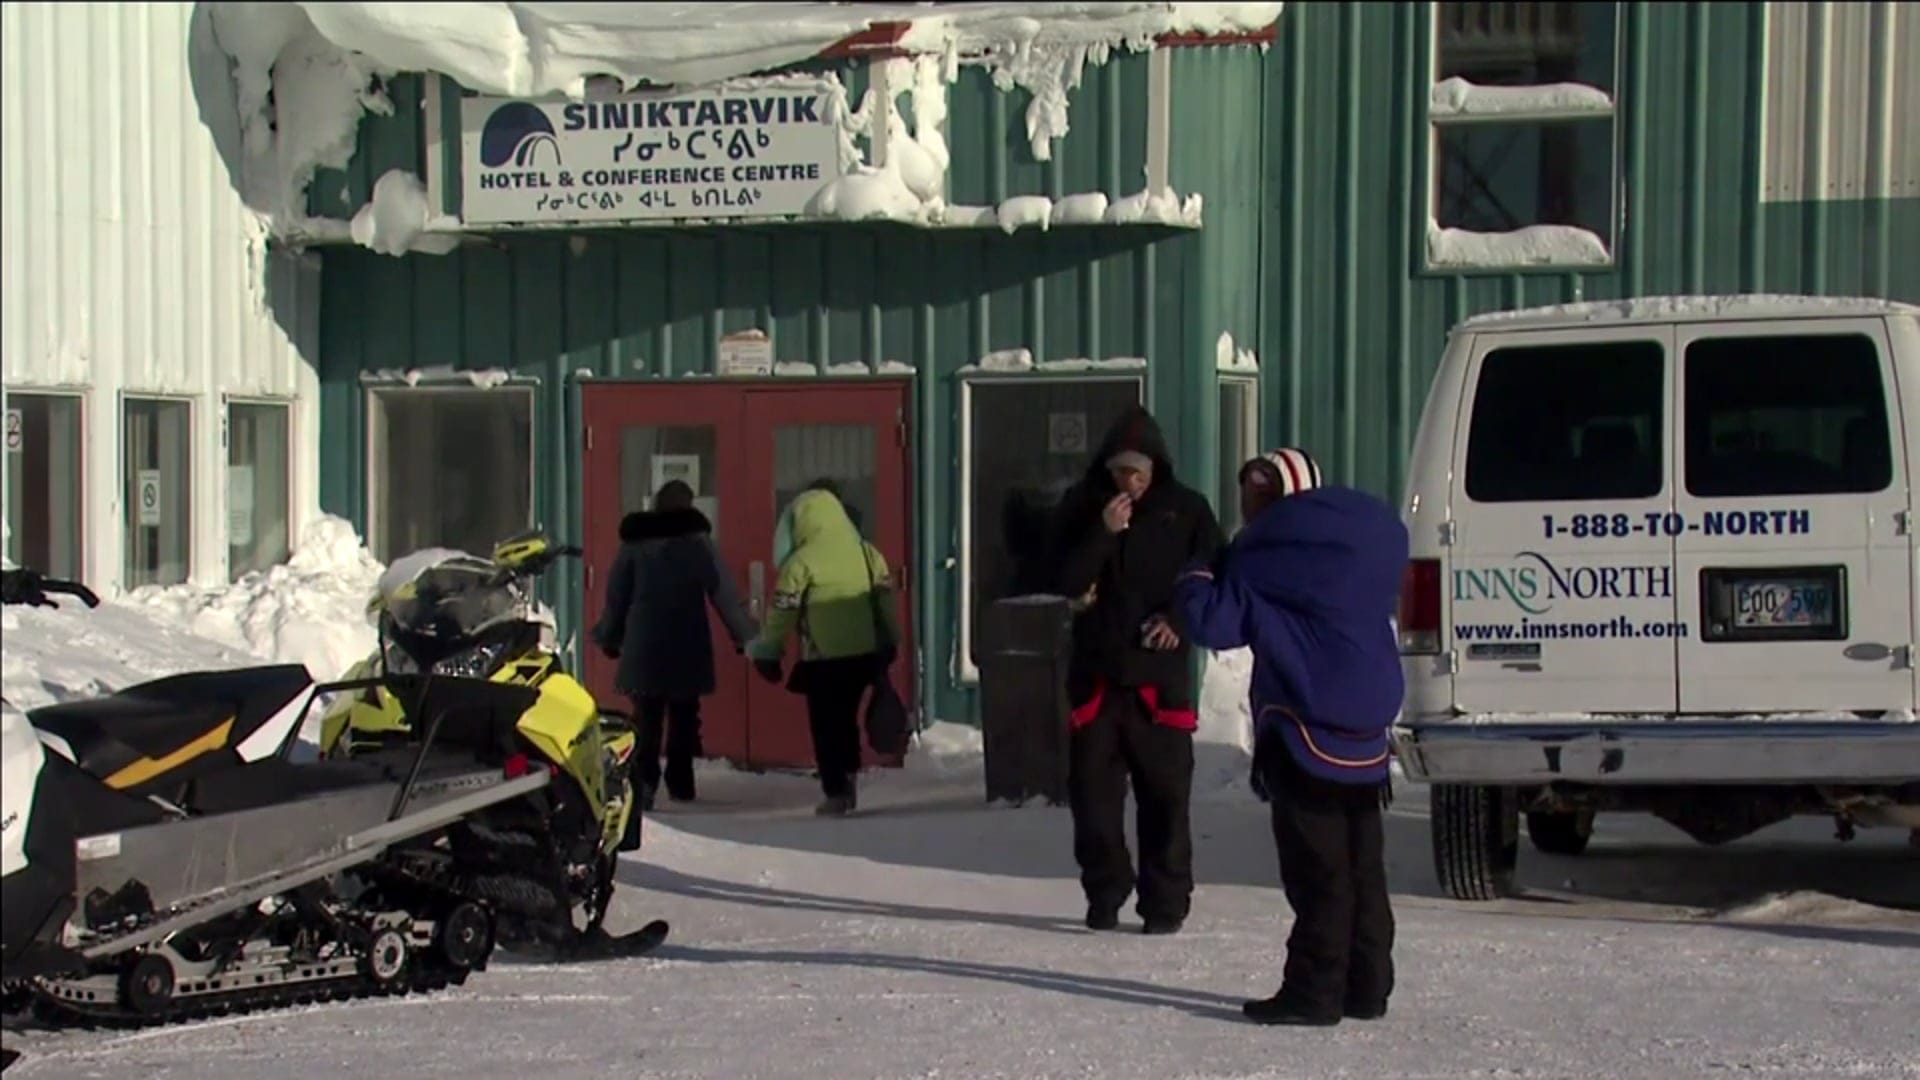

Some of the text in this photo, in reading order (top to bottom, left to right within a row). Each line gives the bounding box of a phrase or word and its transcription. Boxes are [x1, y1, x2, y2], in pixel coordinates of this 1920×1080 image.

[563, 96, 819, 131] SINIKTARVIK
[480, 163, 820, 189] HOTEL & CONFERENCE CENTRE
[1542, 510, 1810, 538] 1-888-TO-NORTH
[1453, 557, 1672, 609] INNS NORTH
[1455, 616, 1688, 640] www.innsnorth.com
